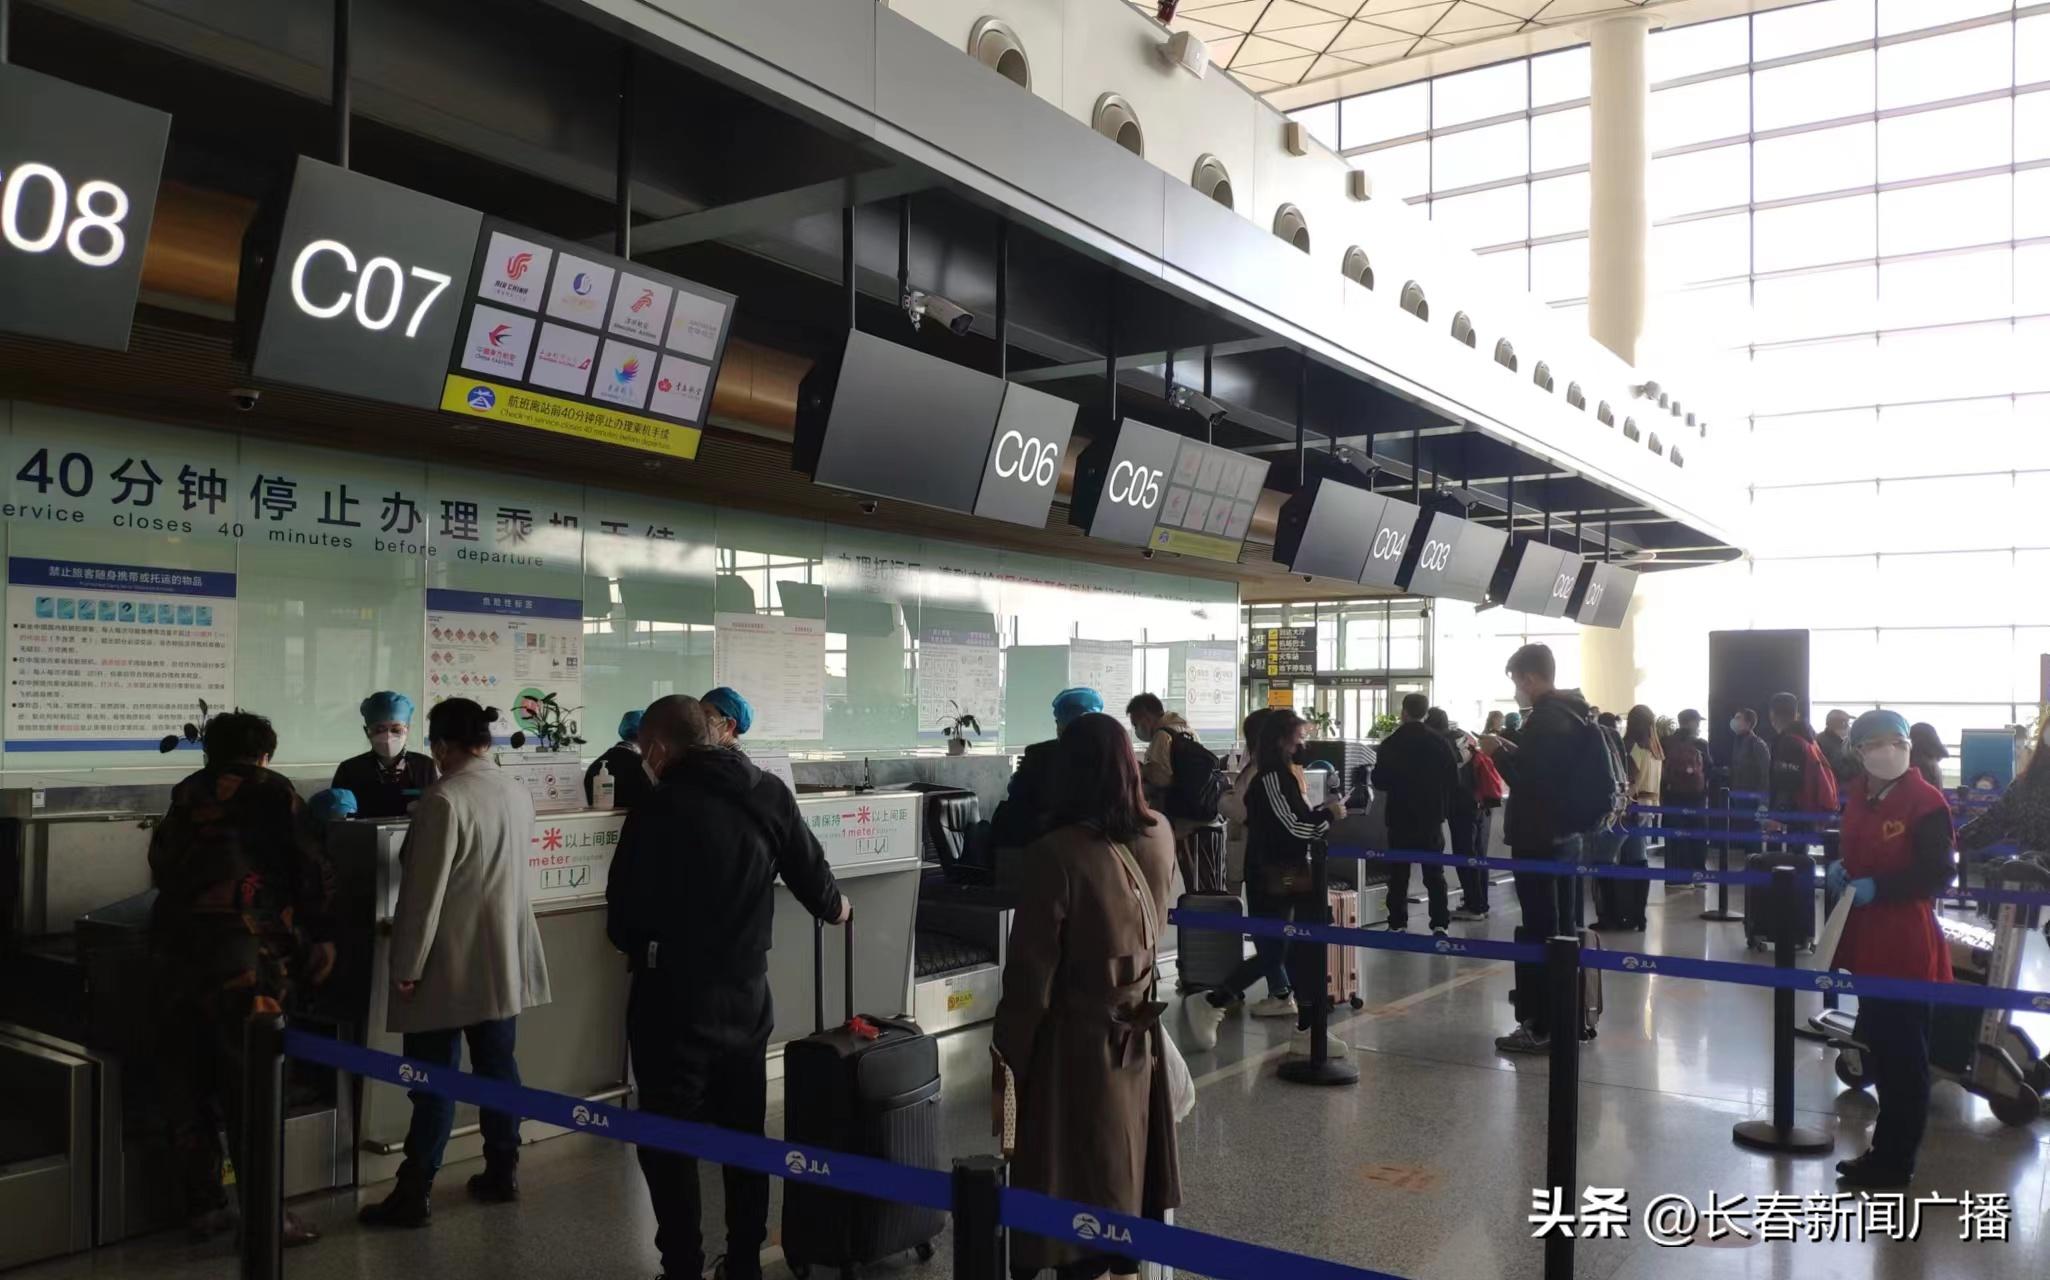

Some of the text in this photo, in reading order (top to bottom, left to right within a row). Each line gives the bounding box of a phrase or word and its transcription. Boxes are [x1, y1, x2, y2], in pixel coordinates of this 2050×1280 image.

[0, 162, 129, 267] 08
[291, 239, 452, 338] C07
[995, 430, 1058, 487] C06
[1109, 460, 1163, 509] C05
[112, 512, 193, 533] closes
[217, 522, 244, 538] 40
[269, 528, 353, 549] minutes
[374, 538, 437, 556] before
[456, 546, 544, 567] departure
[1373, 528, 1406, 562] C04
[1421, 540, 1451, 571] C03
[48, 566, 204, 587] 禁止旅客随身携带或托运的物品
[1552, 574, 1576, 600] C02
[528, 855, 571, 867] meter
[1640, 959, 1657, 969] JLA
[1834, 979, 1854, 989] JLA
[413, 1072, 429, 1083] JLA
[591, 1113, 609, 1128] JLA
[807, 1159, 830, 1176] JLA
[1103, 1223, 1133, 1244] JLA
